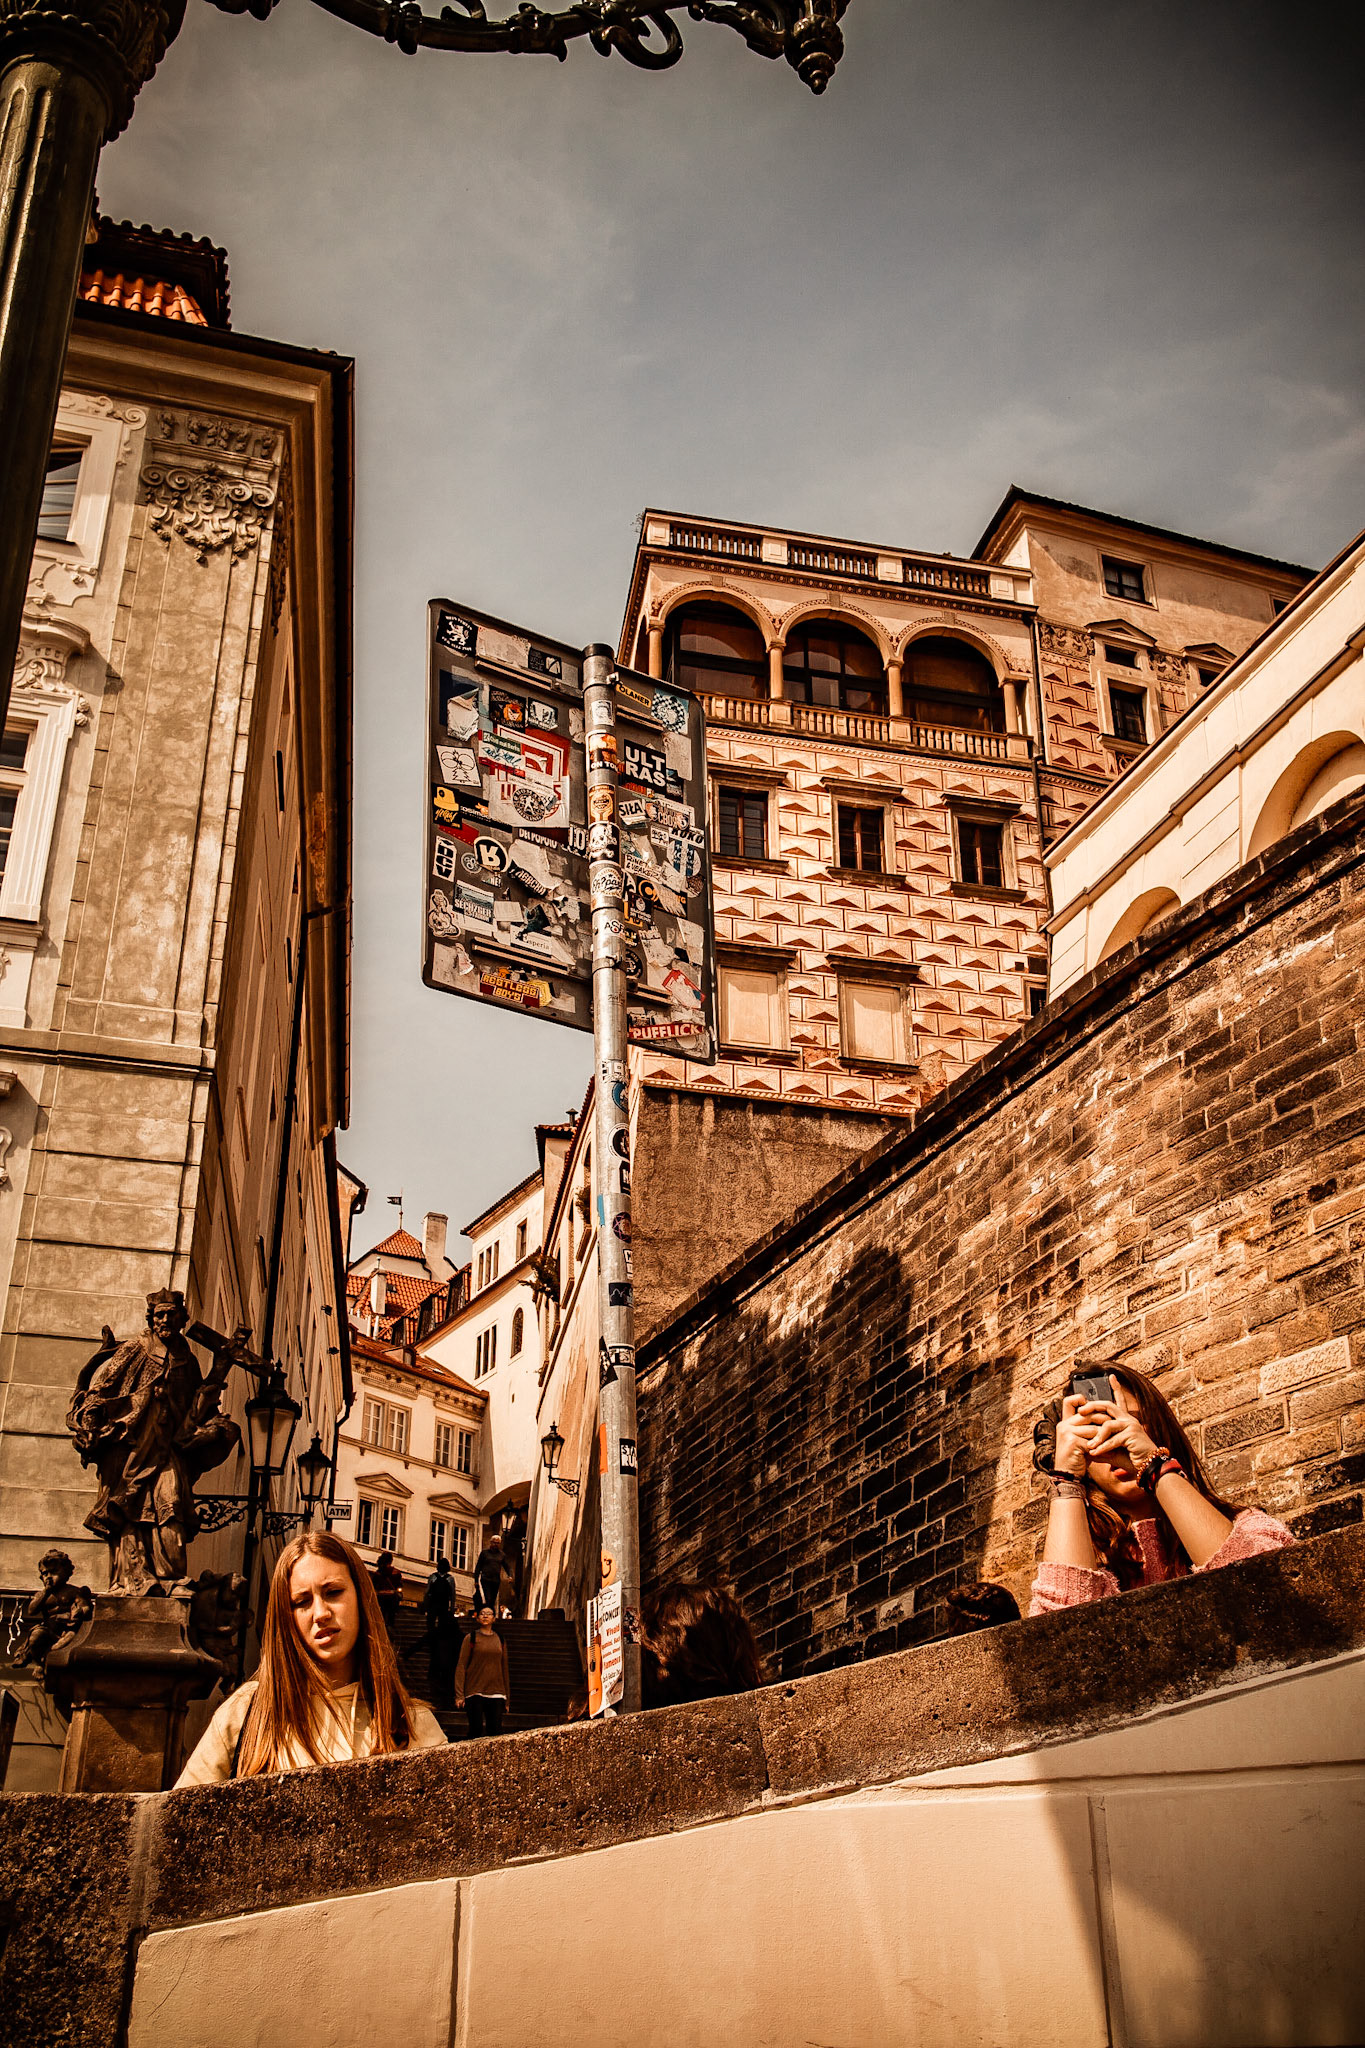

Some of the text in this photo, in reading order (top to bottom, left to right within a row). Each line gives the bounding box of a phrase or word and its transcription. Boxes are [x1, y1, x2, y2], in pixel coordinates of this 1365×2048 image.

[591, 761, 603, 769] ON
[626, 745, 666, 771] ULT
[626, 761, 666, 787] RAS
[495, 987, 521, 1001] BOYS
[329, 1508, 350, 1516] ATM
